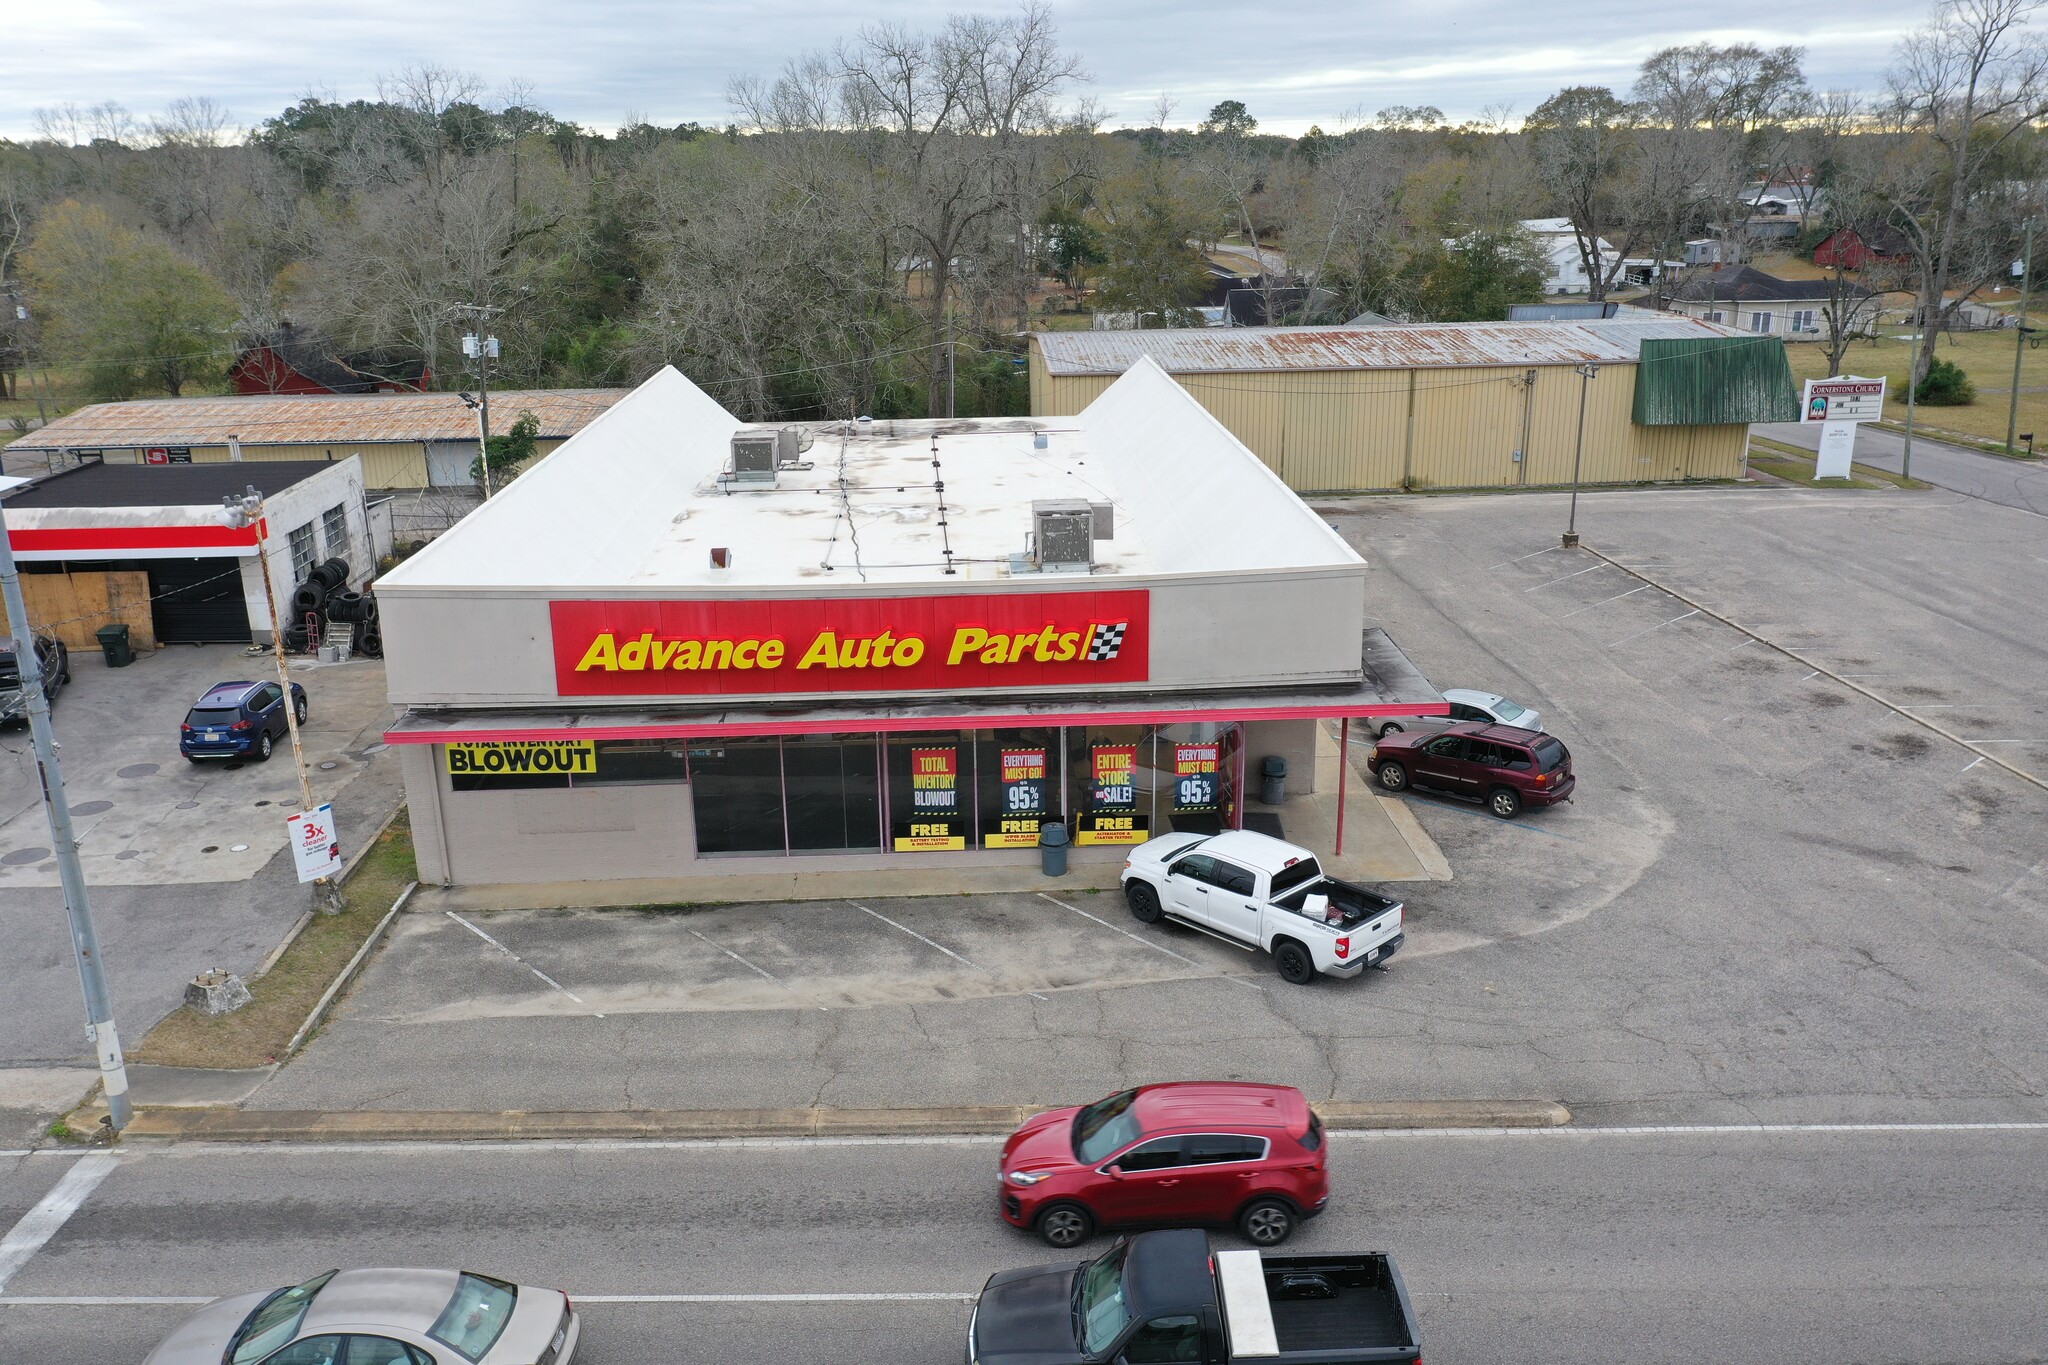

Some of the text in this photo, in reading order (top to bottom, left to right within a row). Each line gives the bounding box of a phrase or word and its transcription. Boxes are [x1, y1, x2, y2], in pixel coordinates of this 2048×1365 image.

[1812, 384, 1881, 394] CORNERSTONE CHURCH
[575, 624, 1081, 671] Advance Auto Parts
[449, 748, 592, 772] BLOWOUT
[1004, 754, 1043, 767] EVERYTHING
[1097, 754, 1132, 769] ENTIRE
[1177, 749, 1216, 761] EVERYTHING
[920, 757, 948, 772] TOTAL
[1178, 761, 1215, 774] MUST GO!
[1005, 767, 1042, 780] MUST GO!
[1098, 770, 1130, 786] STORE
[913, 774, 956, 789] INVENTORY
[914, 791, 956, 806] BLOWOUT
[1103, 786, 1132, 803] SALE!
[911, 823, 949, 837] FREE
[1001, 820, 1039, 833] FREE
[1095, 817, 1133, 830] FREE
[303, 823, 325, 840] 3x
[302, 834, 328, 848] cleaner
